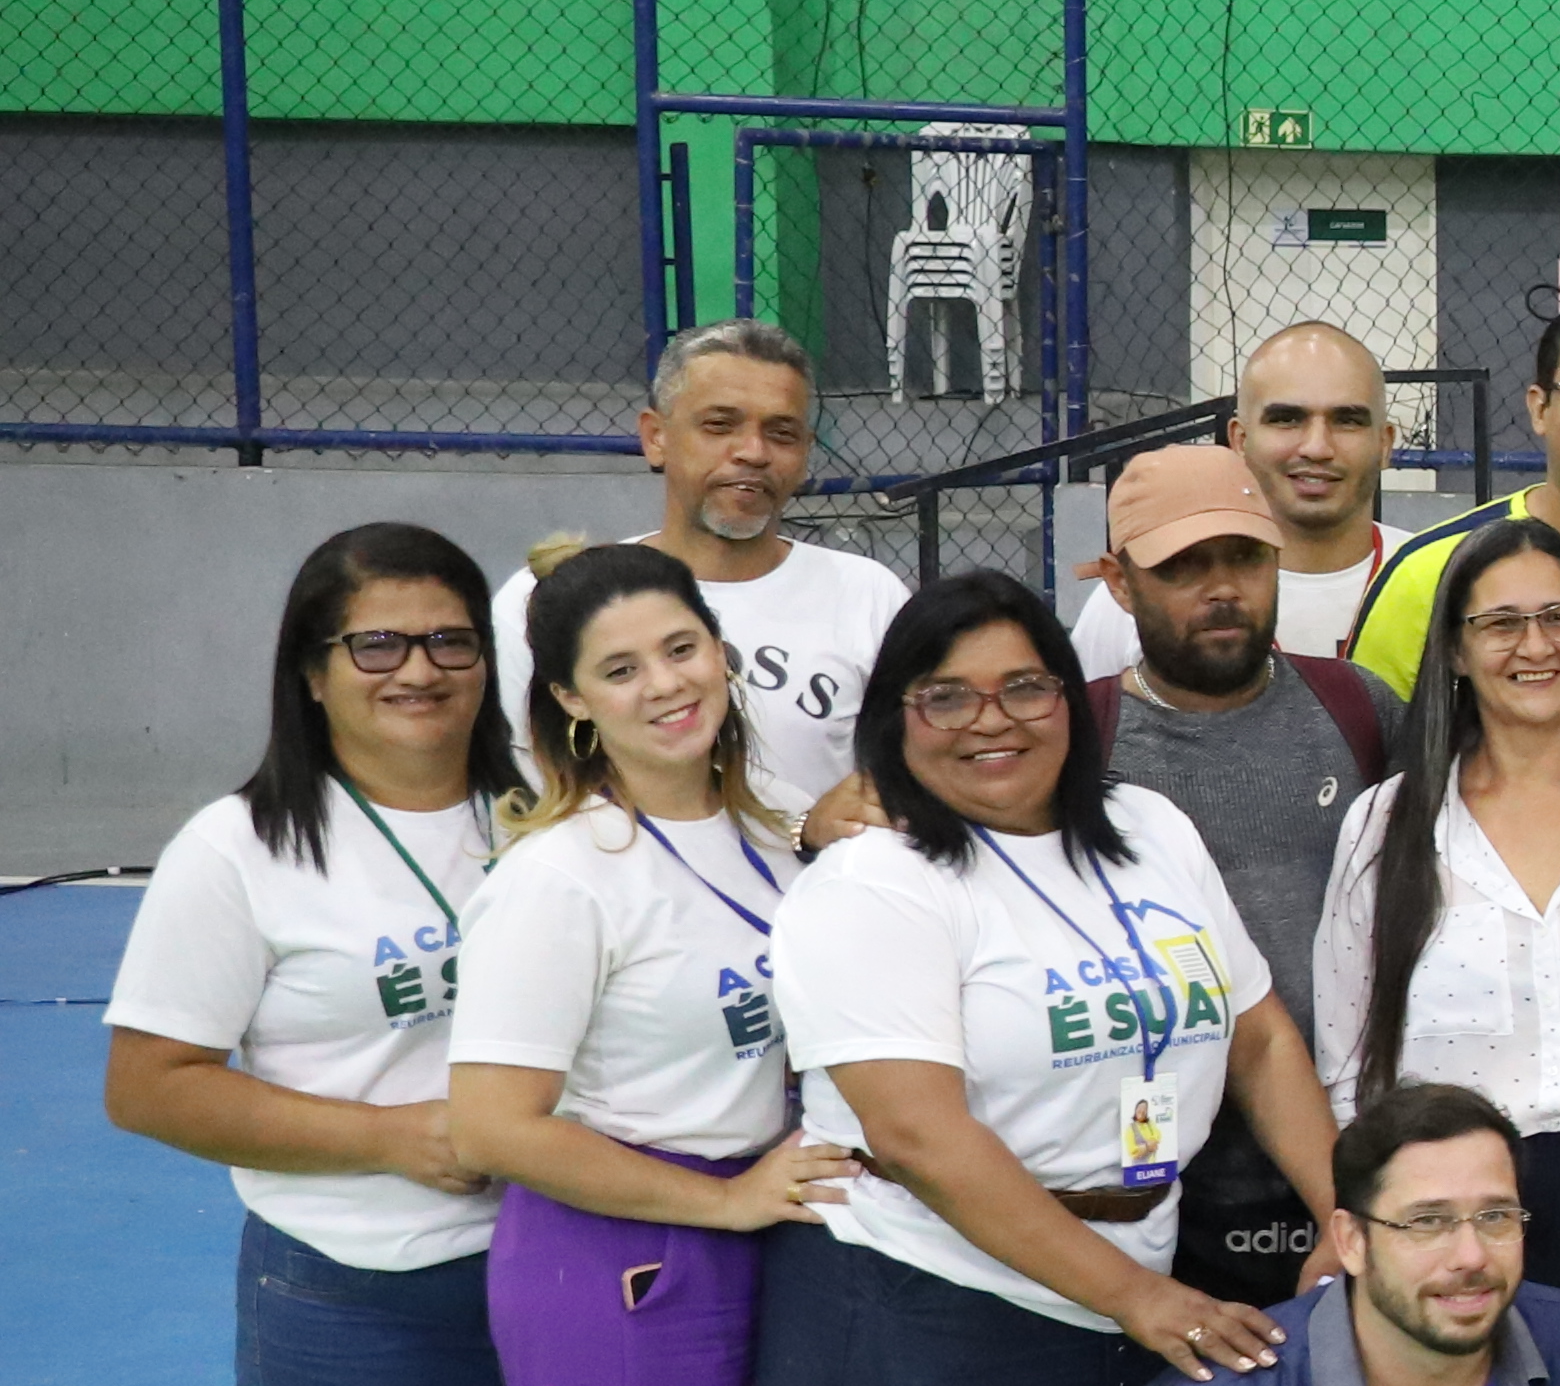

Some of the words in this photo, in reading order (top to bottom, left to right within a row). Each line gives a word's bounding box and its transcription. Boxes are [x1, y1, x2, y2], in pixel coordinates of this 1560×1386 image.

[373, 935, 408, 967] A
[375, 962, 428, 1018] É
[1043, 967, 1075, 996] A
[1047, 995, 1095, 1054] É
[1135, 1167, 1167, 1181] ELIANE
